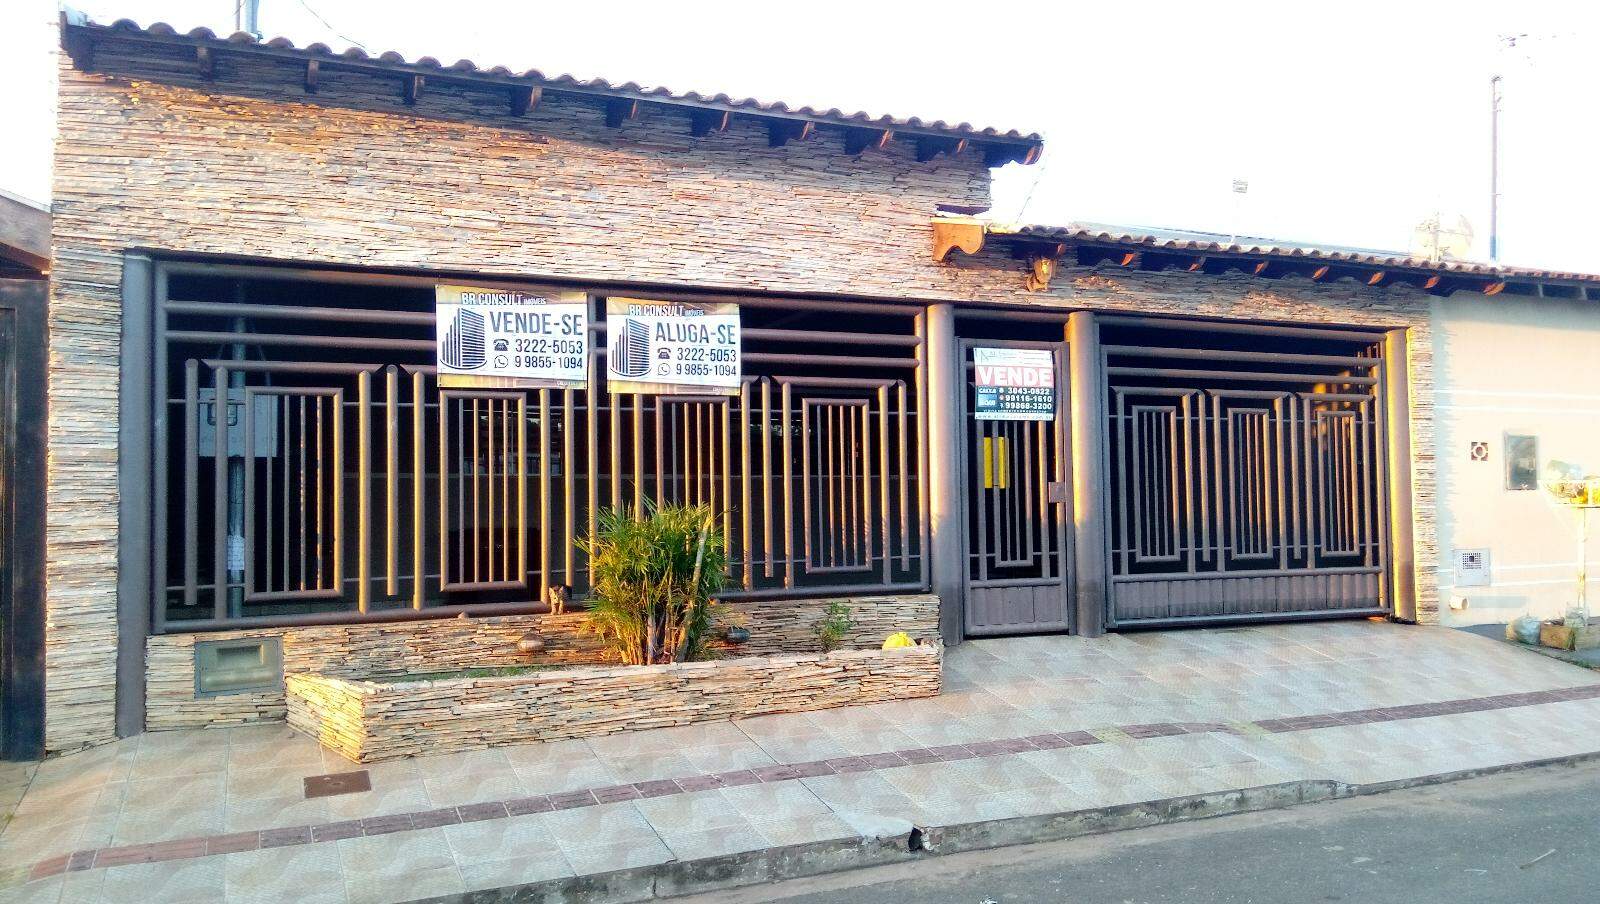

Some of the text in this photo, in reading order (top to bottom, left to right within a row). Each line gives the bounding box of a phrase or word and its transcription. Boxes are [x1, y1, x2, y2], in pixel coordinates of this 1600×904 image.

[461, 293, 476, 305] BR
[478, 293, 523, 305] CONSULT
[629, 304, 641, 316] BR
[643, 304, 684, 317] CONSULT
[490, 311, 583, 336] VENDE-SE
[655, 322, 736, 345] ALUGA-SE
[515, 338, 583, 354] 3222-5053
[677, 347, 737, 362] 3222-5053
[515, 356, 583, 369] 9 9855-1094
[676, 364, 737, 376] 9 9855-1094
[977, 366, 1052, 387] VENDE
